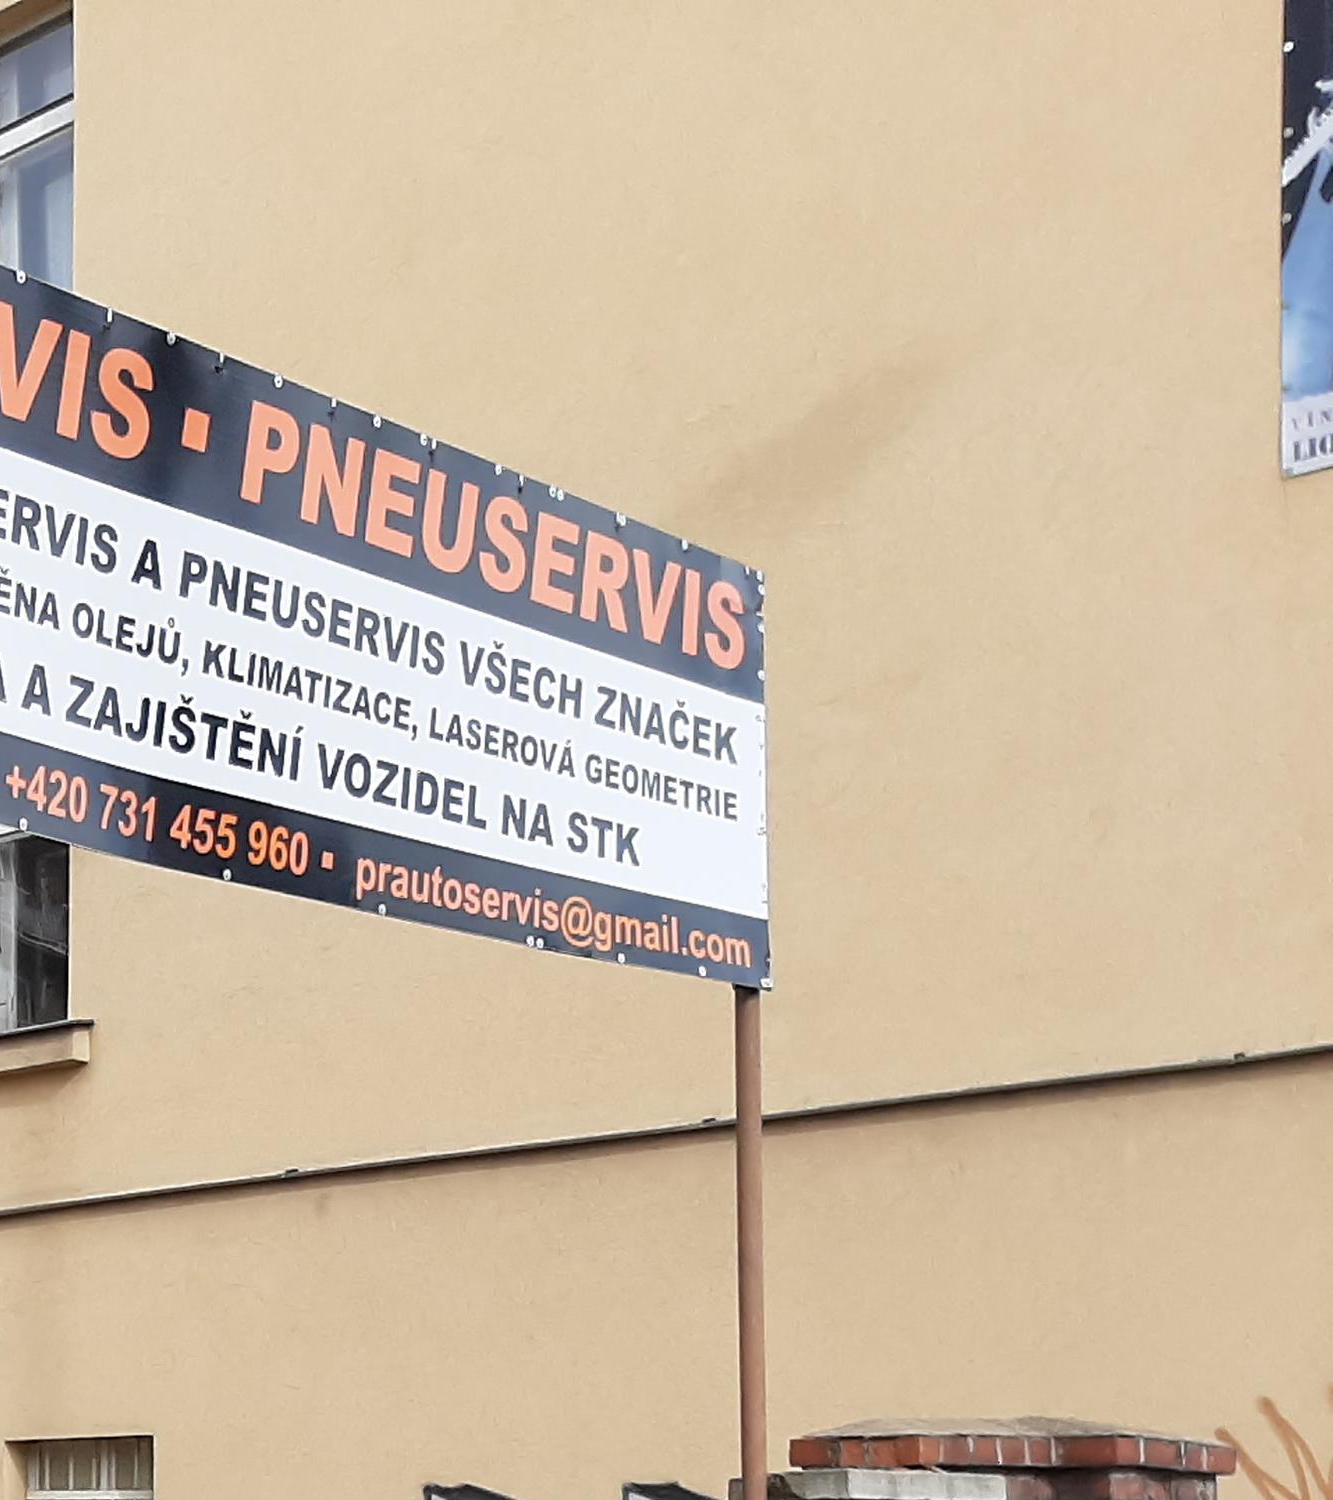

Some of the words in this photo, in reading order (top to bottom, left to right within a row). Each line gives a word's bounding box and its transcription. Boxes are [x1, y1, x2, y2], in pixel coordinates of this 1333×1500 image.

[240, 399, 746, 670] PNEUSERVIS
[71, 602, 190, 678] OLEJŮ,
[202, 640, 419, 741] KLIMATIZACE,
[428, 707, 576, 778] LASEROVÁ
[585, 754, 738, 822] GEOMETRIE
[130, 539, 163, 591] A
[178, 550, 446, 675] PNEUSERVIS
[459, 640, 583, 719] VŠECH
[593, 685, 738, 765] ZNAČEK
[4, 764, 89, 823] +420
[98, 783, 157, 841] 731
[169, 802, 239, 860] 455
[247, 820, 310, 877] 960
[355, 857, 753, 969] prautoservis@gmail.com
[20, 664, 52, 716] A
[65, 674, 305, 782] ZAJIŠTĚNÍ
[317, 742, 487, 831] VOZIDEL
[500, 793, 554, 847] NA
[566, 811, 641, 867] STK
